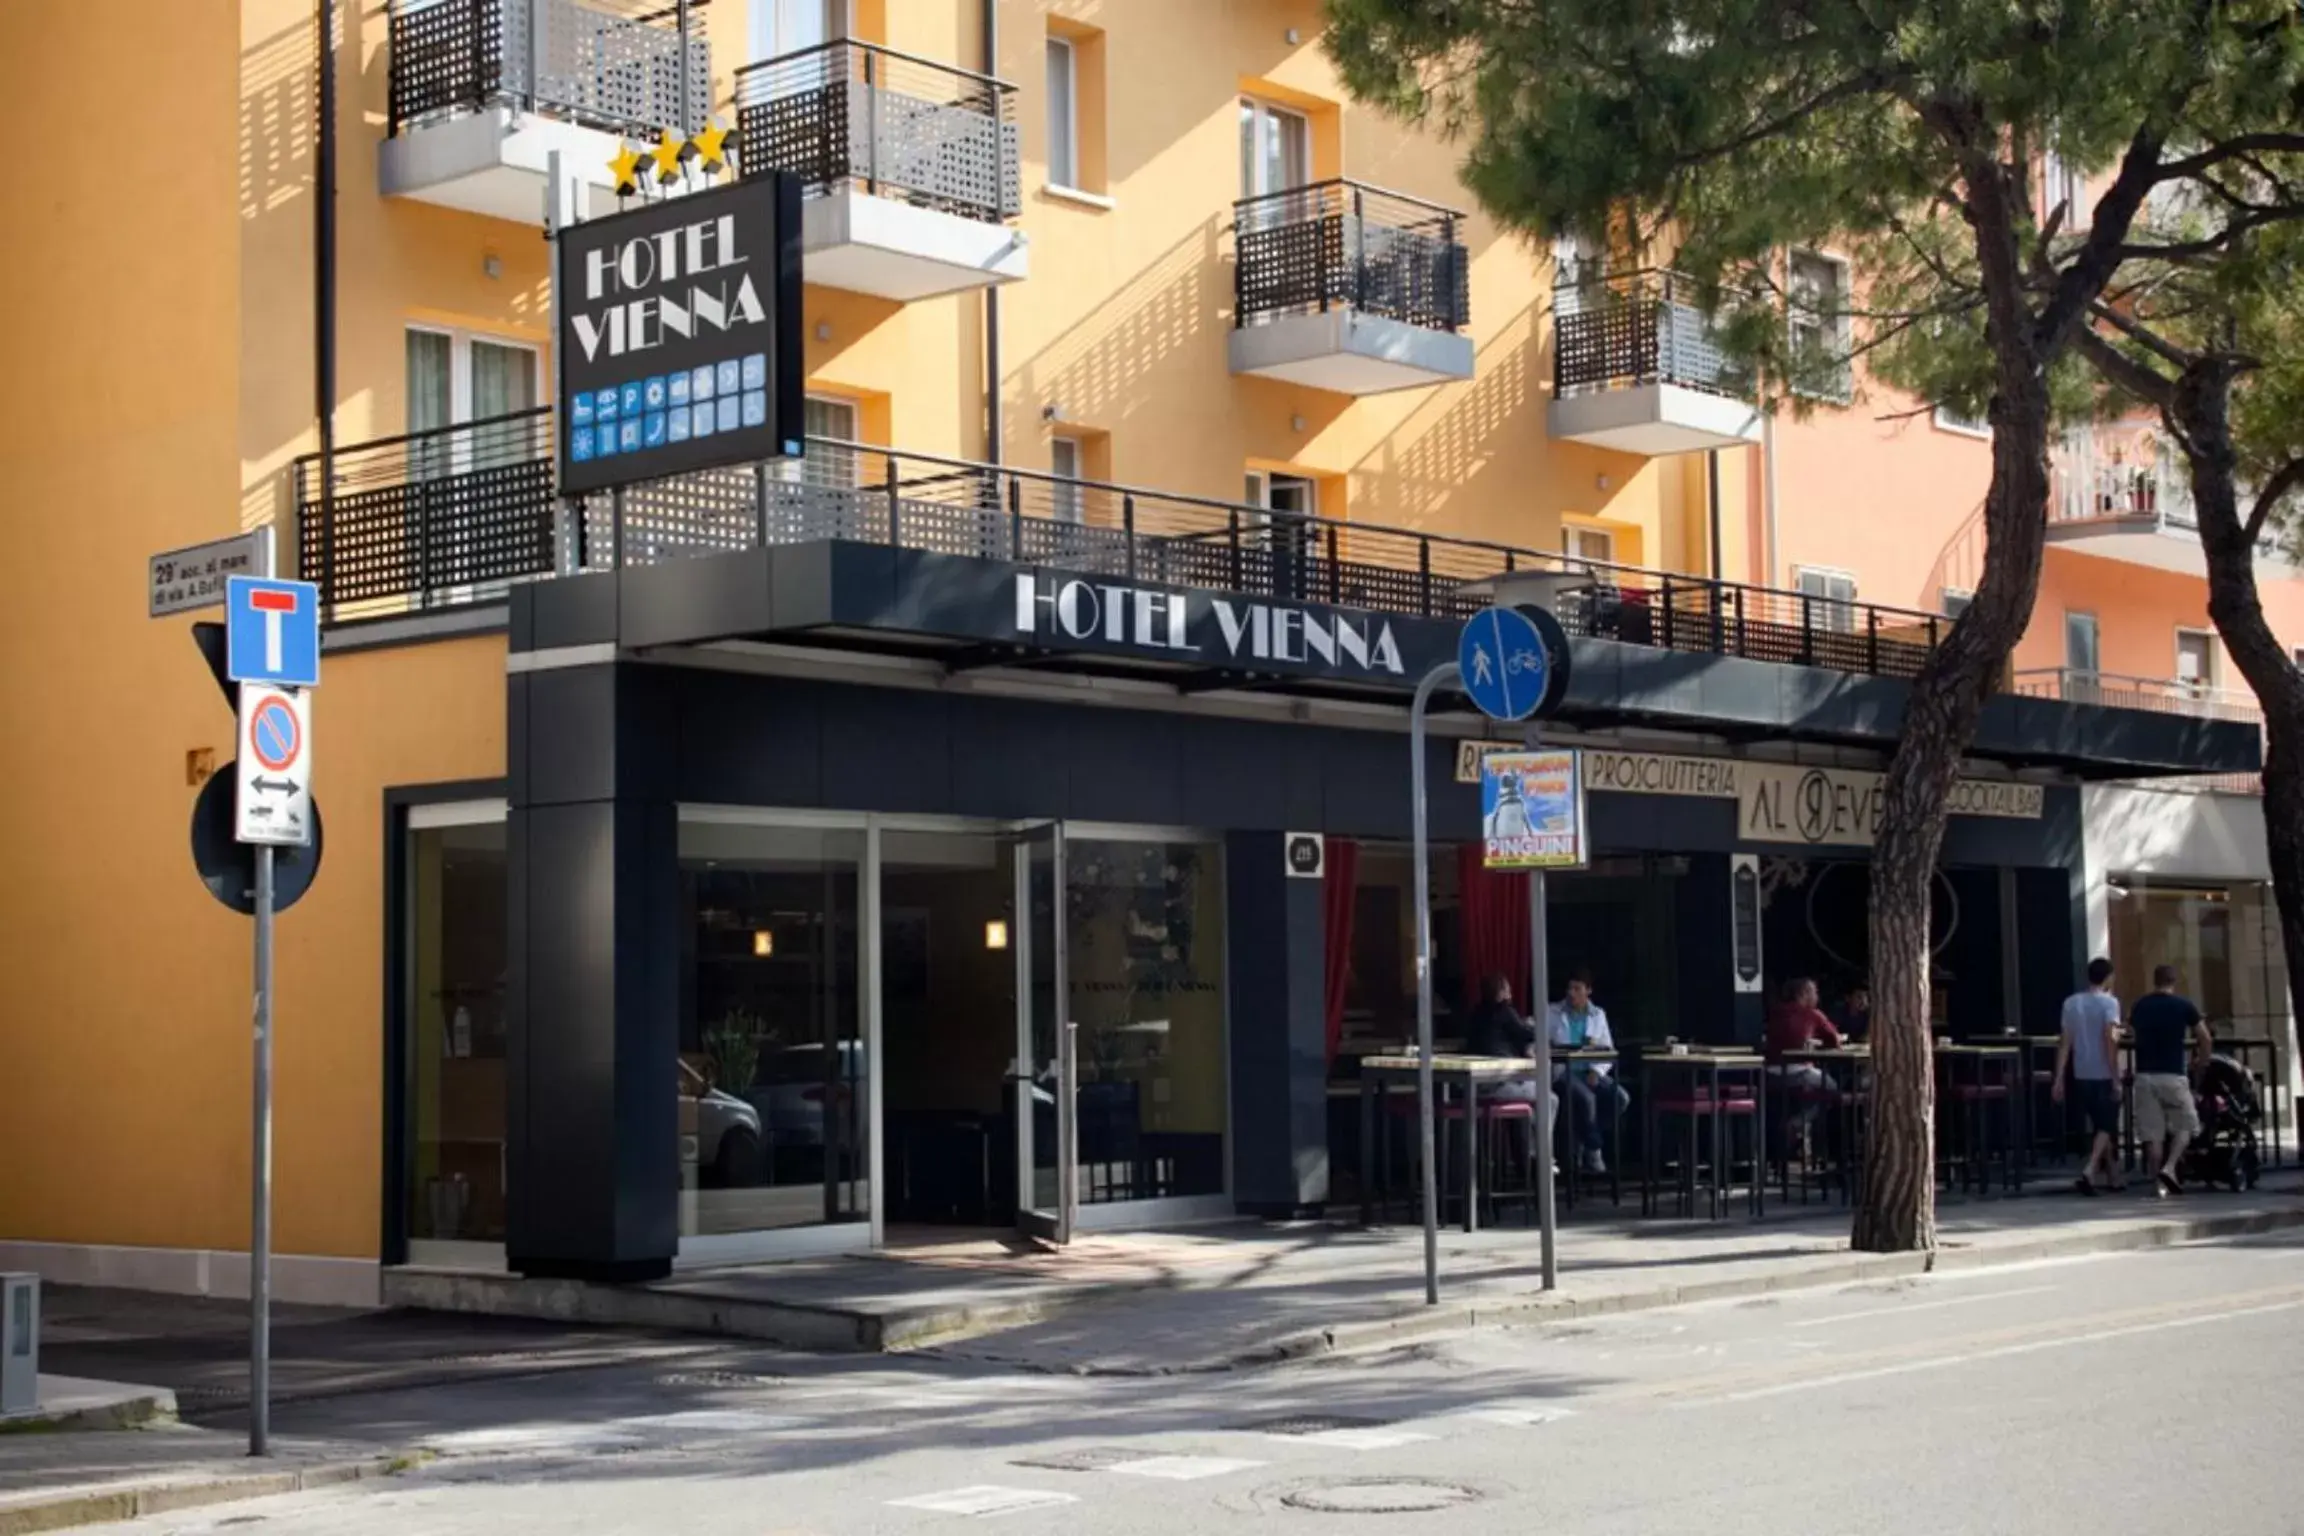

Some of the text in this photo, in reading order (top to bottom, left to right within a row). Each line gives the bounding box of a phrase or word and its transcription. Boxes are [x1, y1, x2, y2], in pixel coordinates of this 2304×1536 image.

[587, 214, 748, 300] HOTEL
[571, 272, 766, 363] VIENNA
[1016, 573, 1404, 674] HOTEL VIENNA
[1592, 754, 1736, 793] PROSCIUTTERIA
[1486, 836, 1573, 857] PINGUINI
